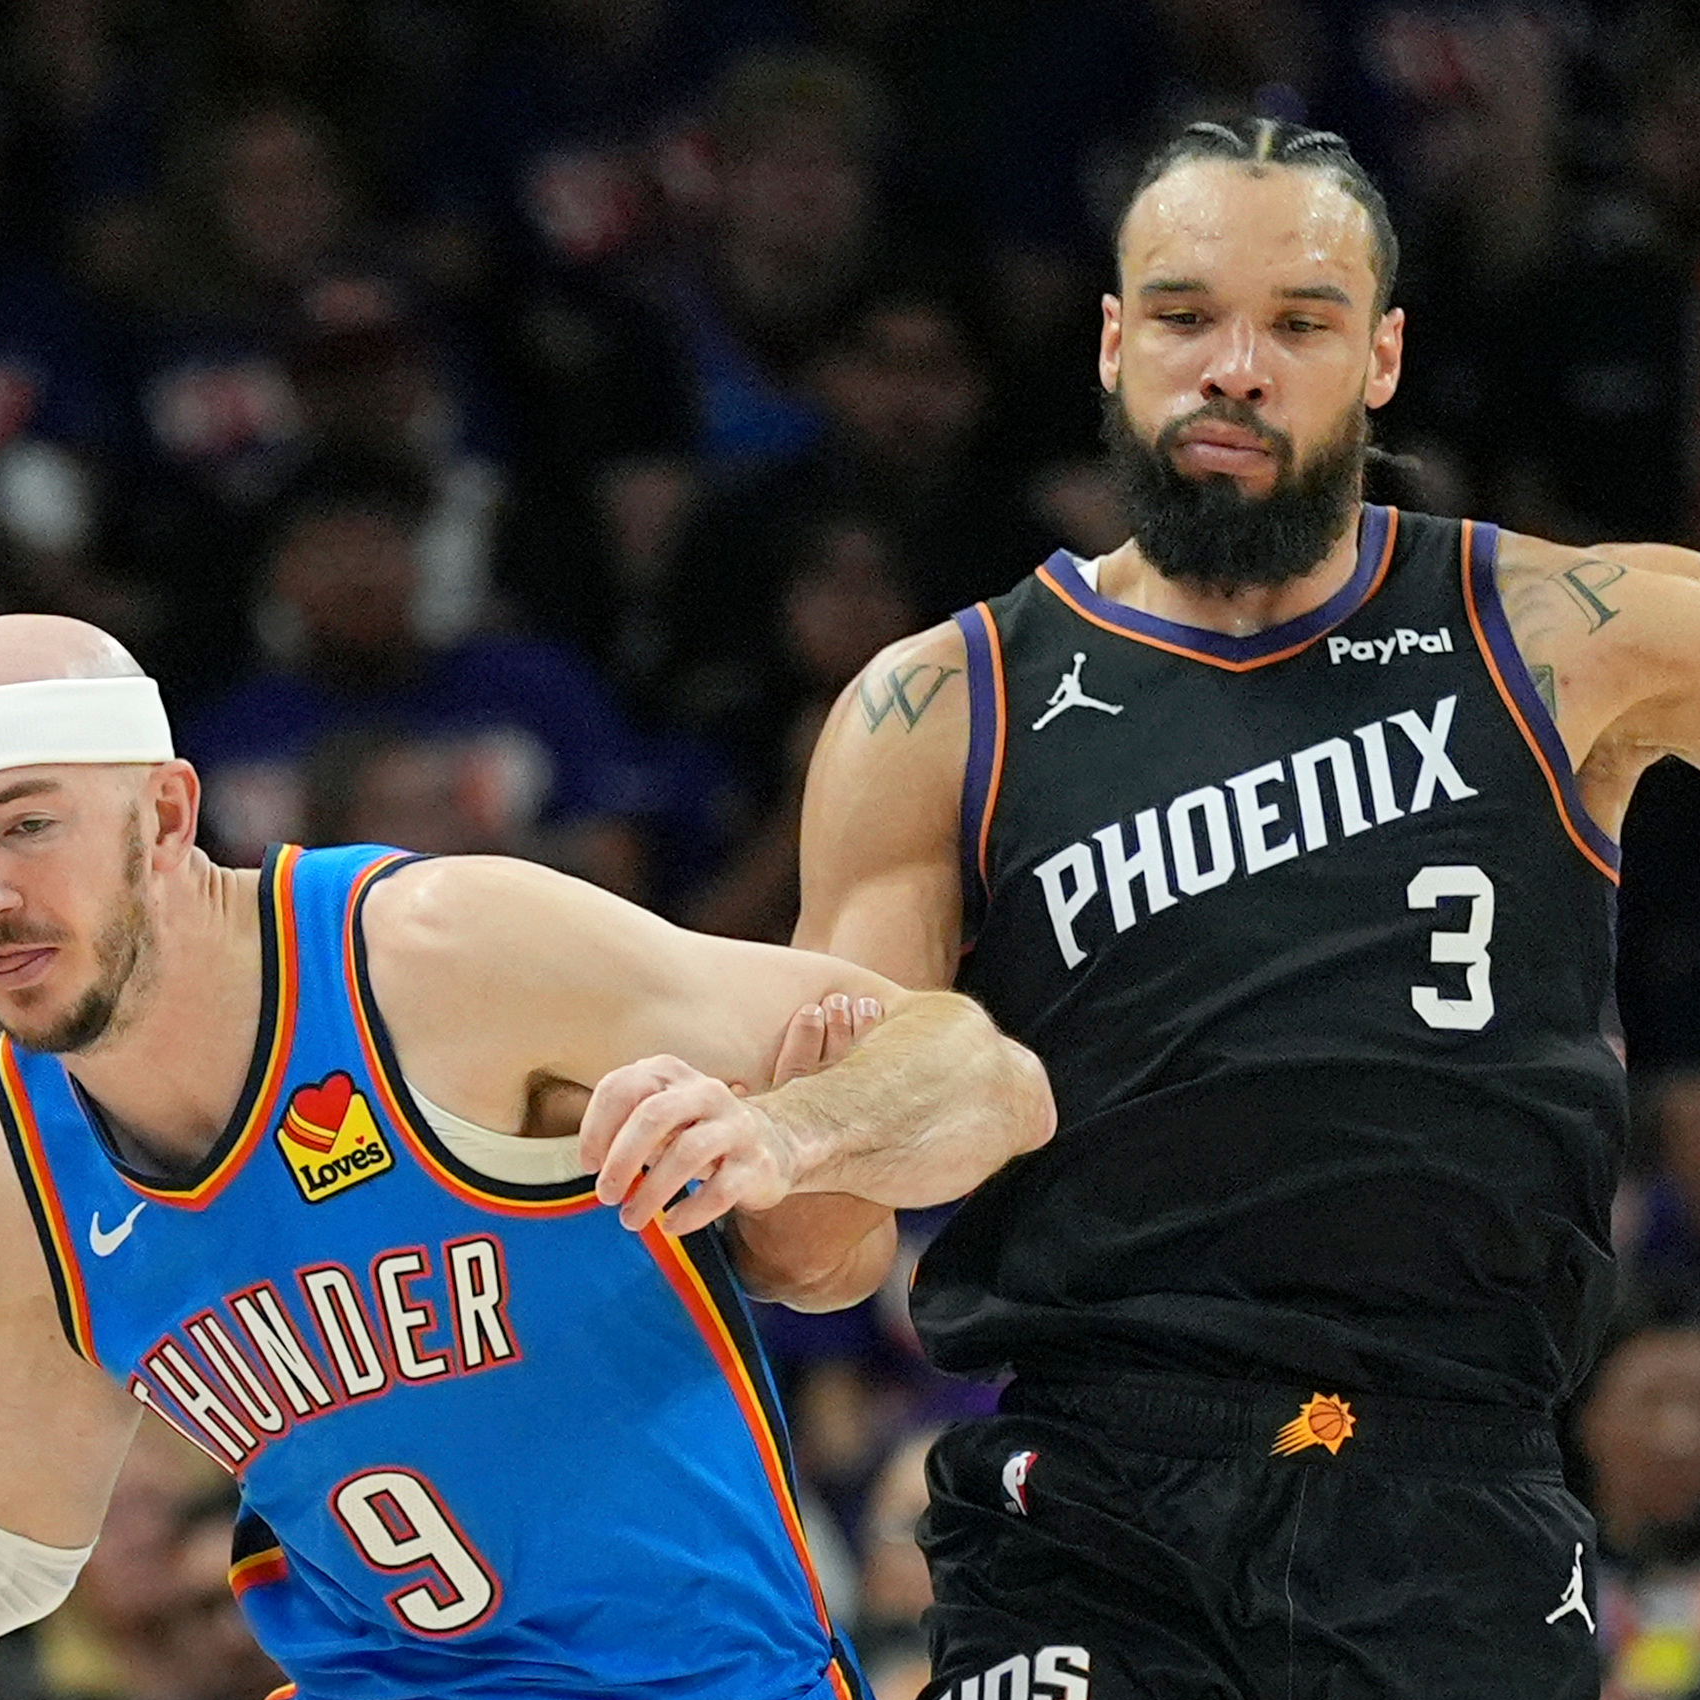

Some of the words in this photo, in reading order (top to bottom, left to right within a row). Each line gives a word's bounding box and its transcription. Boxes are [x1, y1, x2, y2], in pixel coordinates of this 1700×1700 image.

[1327, 627, 1453, 665] PayPal
[1033, 694, 1479, 970] PHOENIX
[1406, 864, 1495, 1031] 3
[330, 1465, 502, 1639] 9
